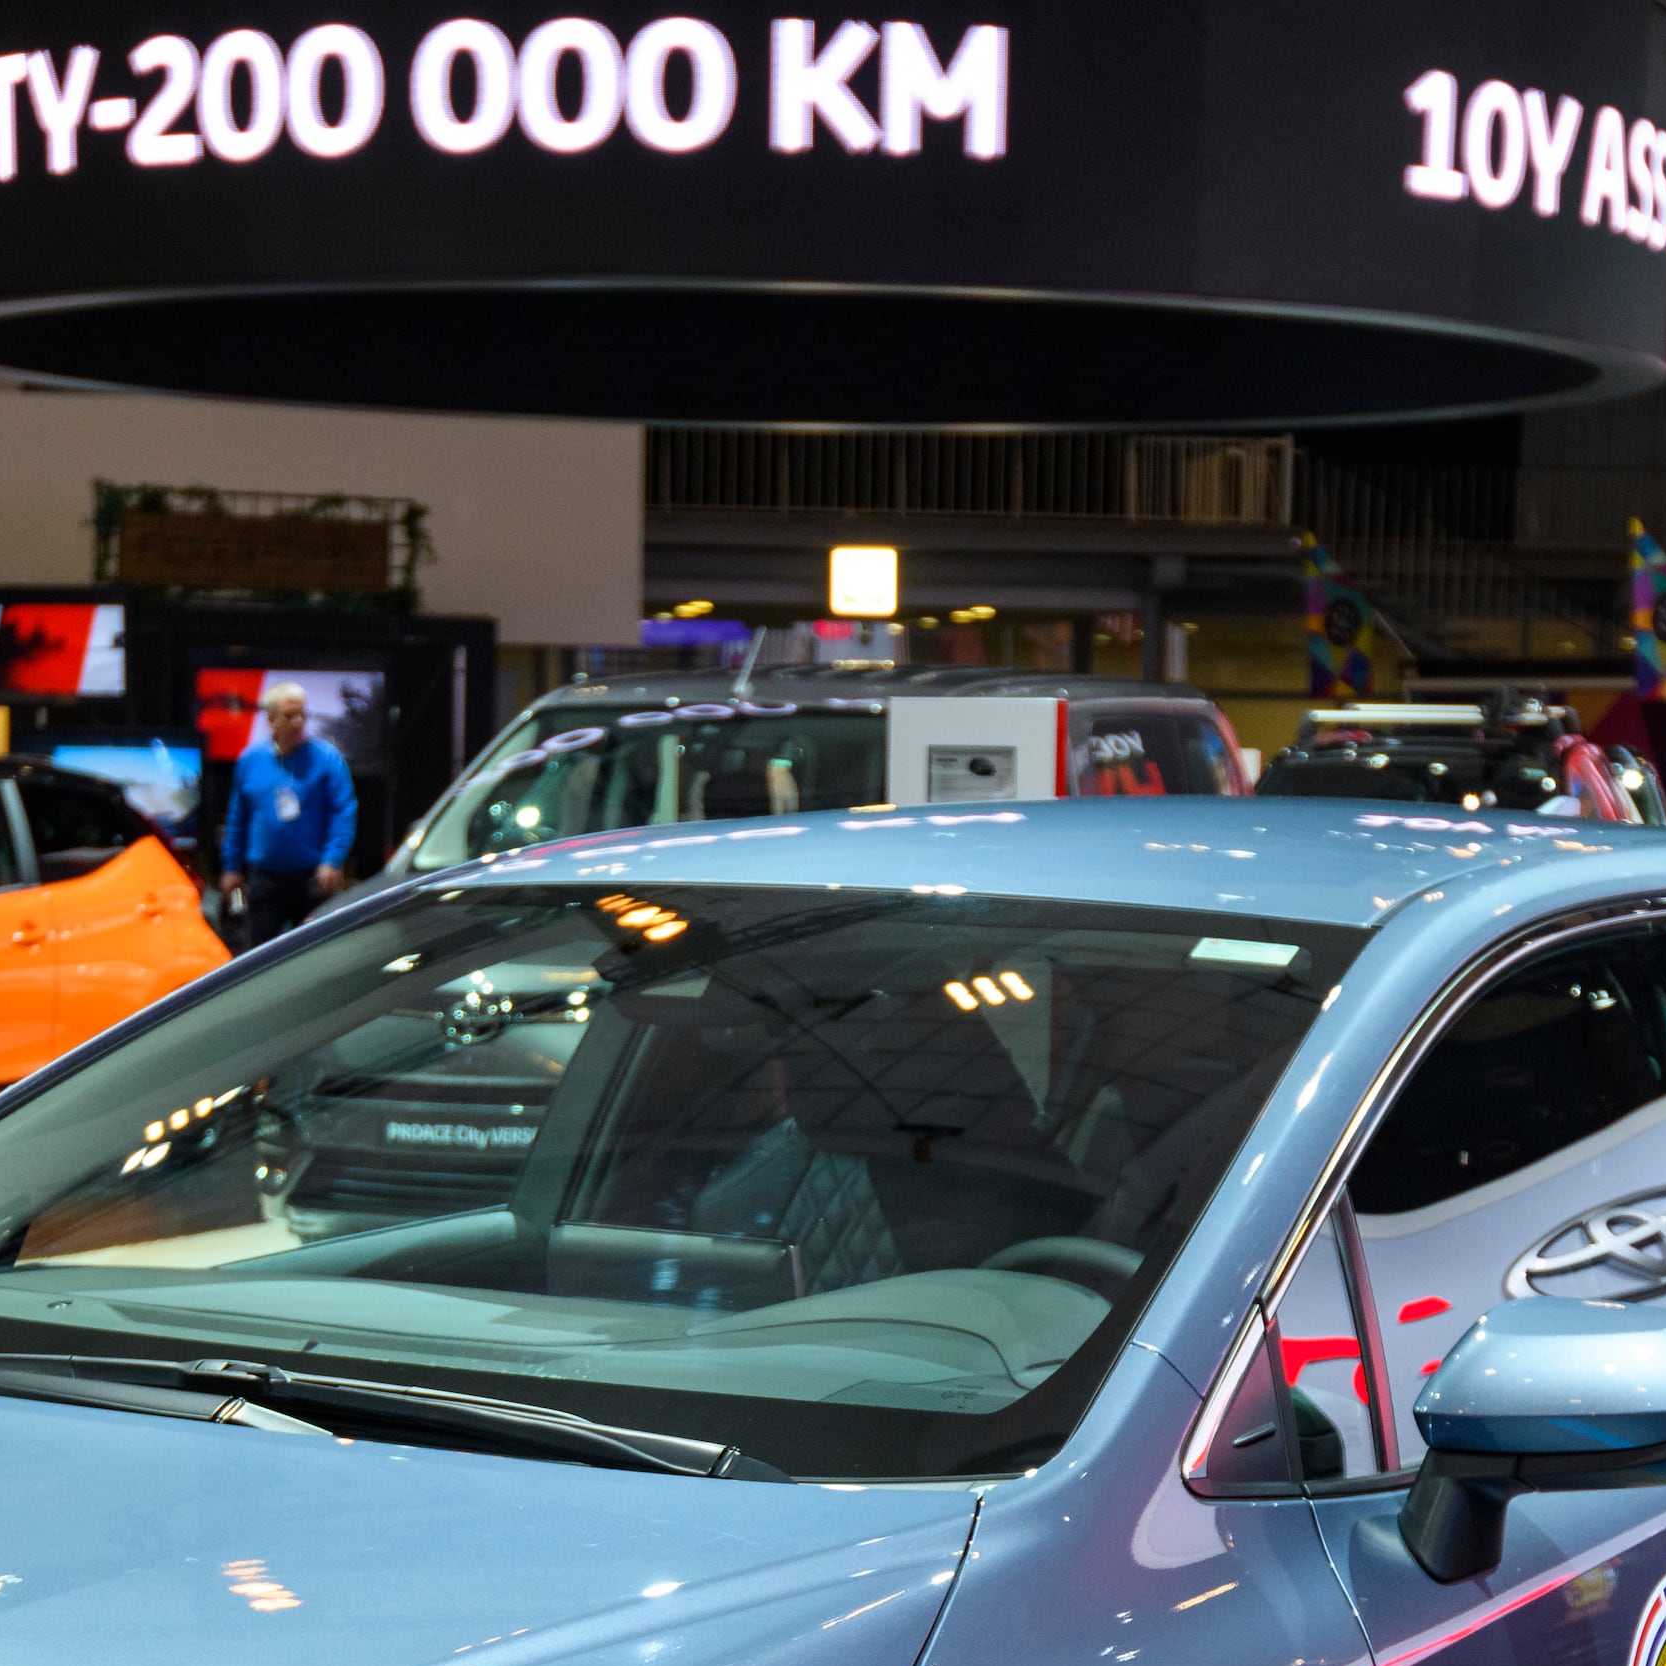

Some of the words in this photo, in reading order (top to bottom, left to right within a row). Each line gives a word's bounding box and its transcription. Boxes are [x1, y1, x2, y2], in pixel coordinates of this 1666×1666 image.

[409, 16, 738, 155] 000
[769, 16, 1010, 159] KM
[1403, 68, 1583, 217] 10Y
